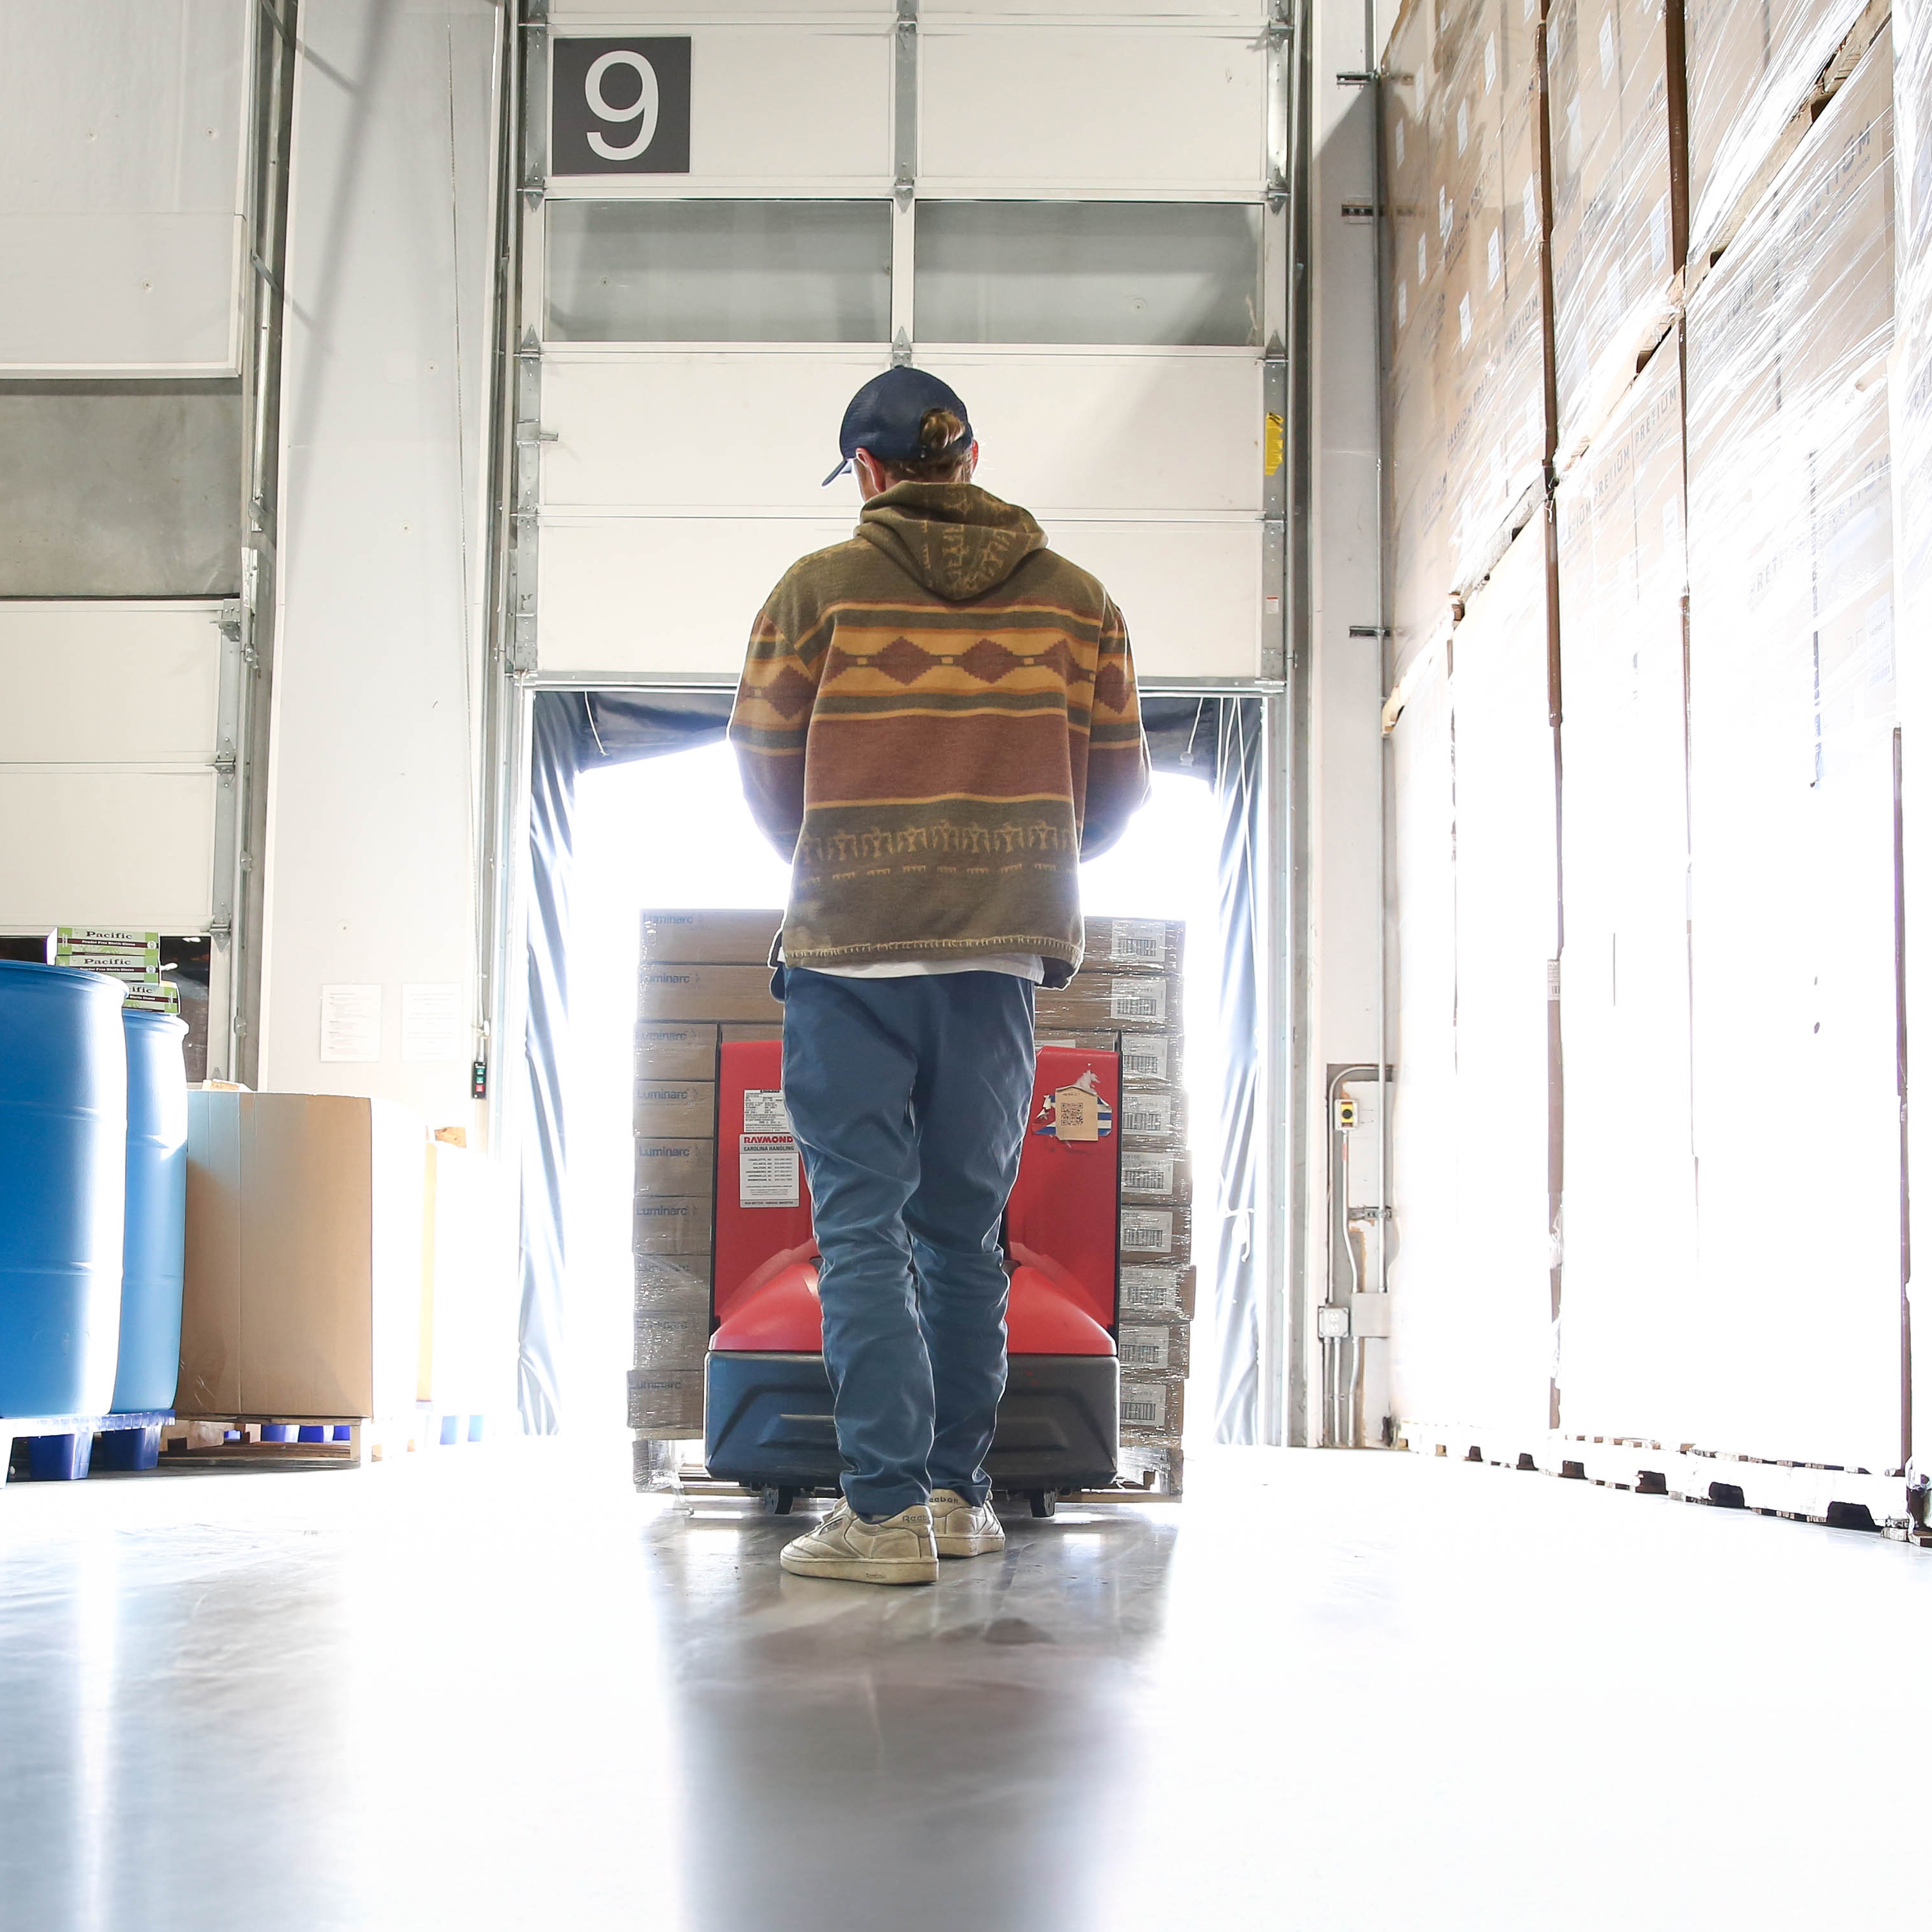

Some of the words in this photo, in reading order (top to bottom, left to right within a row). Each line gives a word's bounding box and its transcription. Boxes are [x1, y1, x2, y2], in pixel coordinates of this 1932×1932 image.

[584, 50, 659, 161] 9
[86, 931, 132, 939] Pacific
[637, 1089, 687, 1099] Luminarc
[639, 1147, 690, 1157] Luminarc
[637, 1206, 687, 1216] Luminarc
